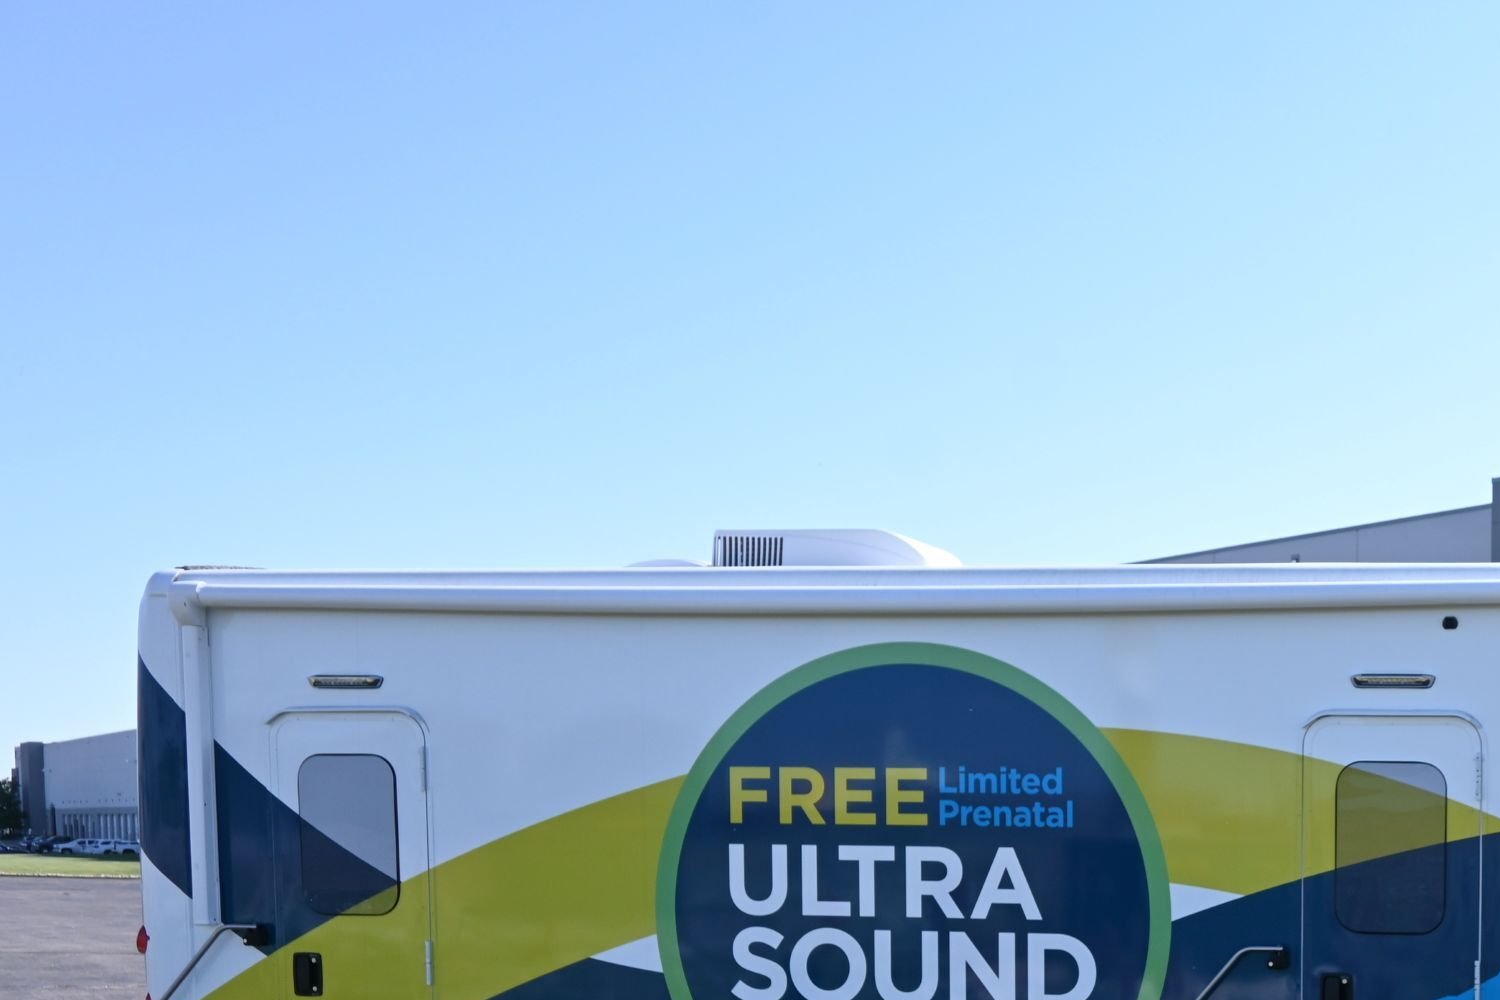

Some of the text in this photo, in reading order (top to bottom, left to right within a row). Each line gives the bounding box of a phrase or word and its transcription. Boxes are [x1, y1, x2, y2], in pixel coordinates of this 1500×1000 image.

[729, 766, 929, 826] FREE
[938, 765, 1064, 795] Limited
[938, 799, 1075, 829] Prenatal
[728, 843, 1043, 921] ULTRA
